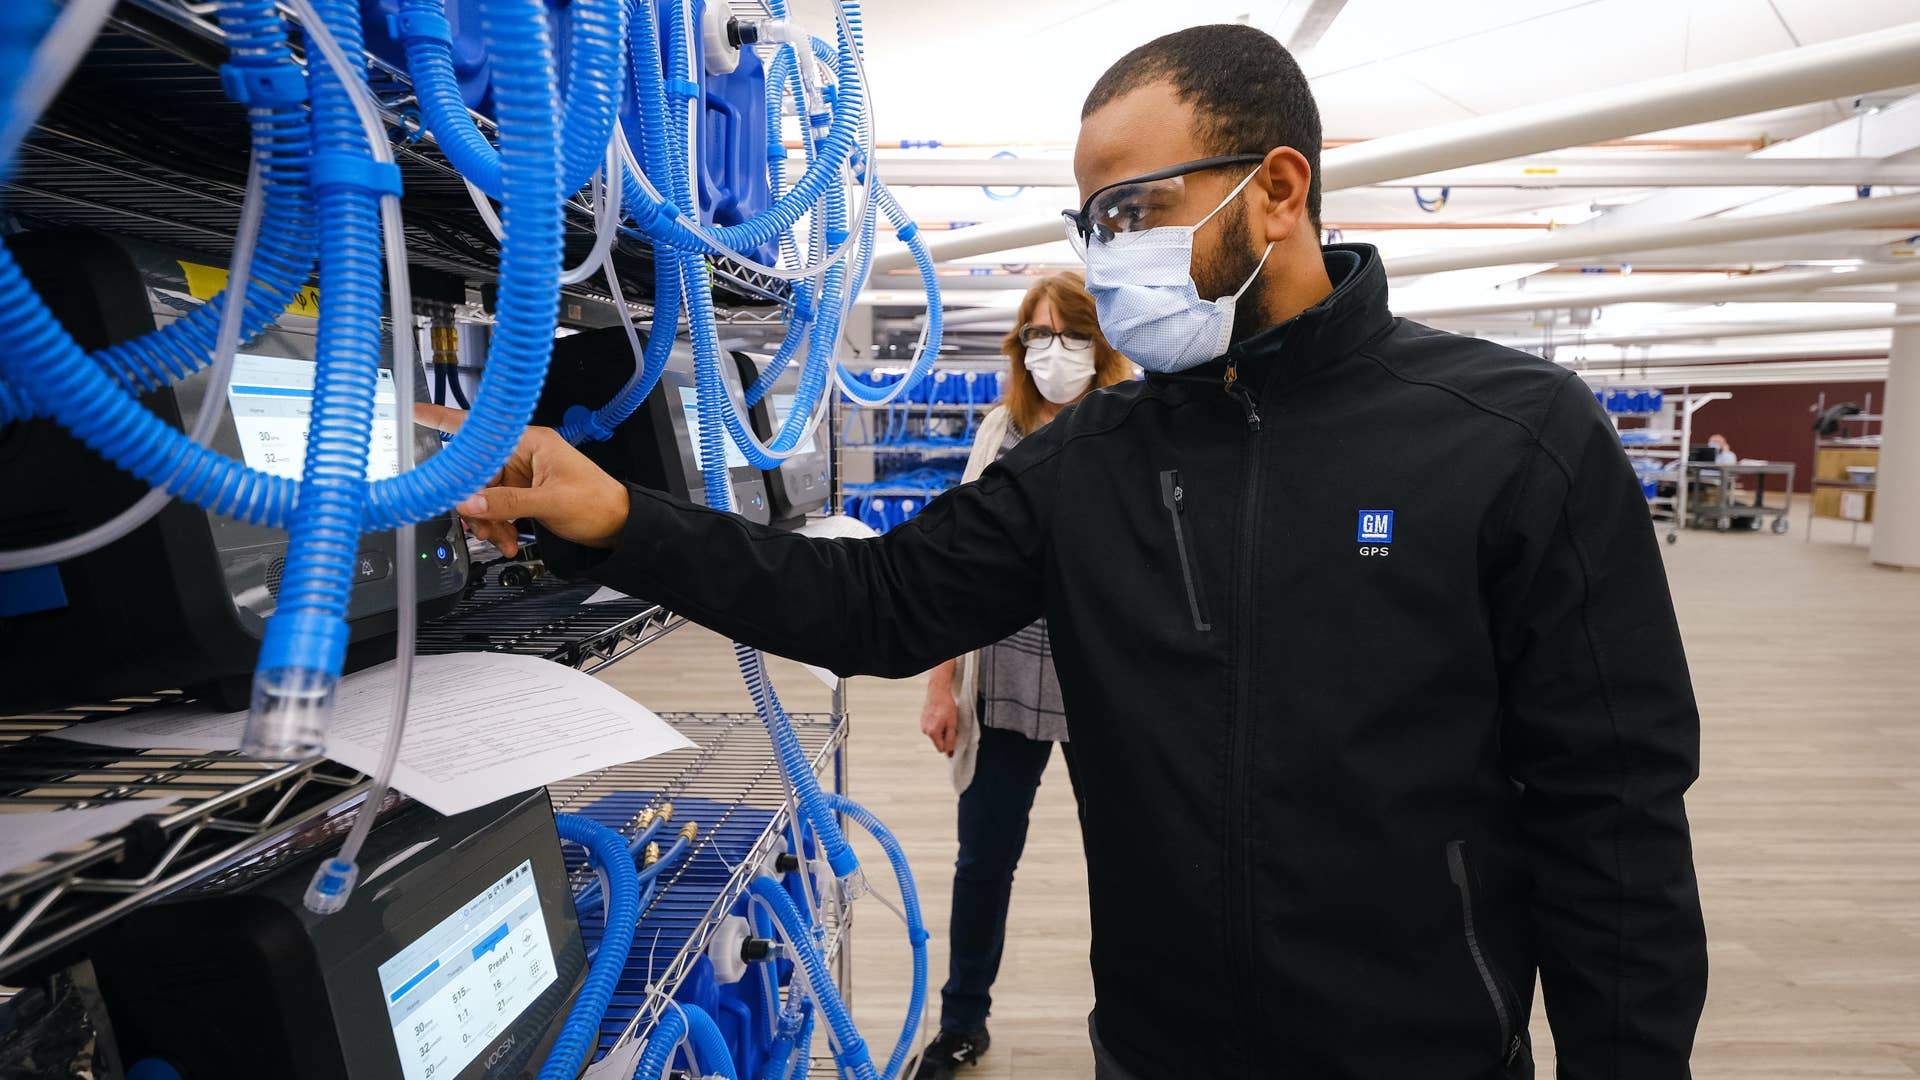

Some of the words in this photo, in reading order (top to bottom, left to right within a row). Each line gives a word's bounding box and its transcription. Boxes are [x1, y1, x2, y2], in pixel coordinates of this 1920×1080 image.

[259, 431, 270, 441] 30
[264, 453, 276, 463] 32
[1363, 514, 1389, 533] GM
[1359, 546, 1389, 557] GPS
[488, 952, 509, 973] Preset
[493, 979, 502, 991] 16
[452, 986, 466, 1004] 515
[497, 999, 506, 1011] 21
[457, 1008, 469, 1022] 1:1
[414, 1022, 425, 1037] 30
[419, 1042, 430, 1057] 32
[484, 1033, 516, 1070] VOCSN
[425, 1064, 435, 1079] 20
